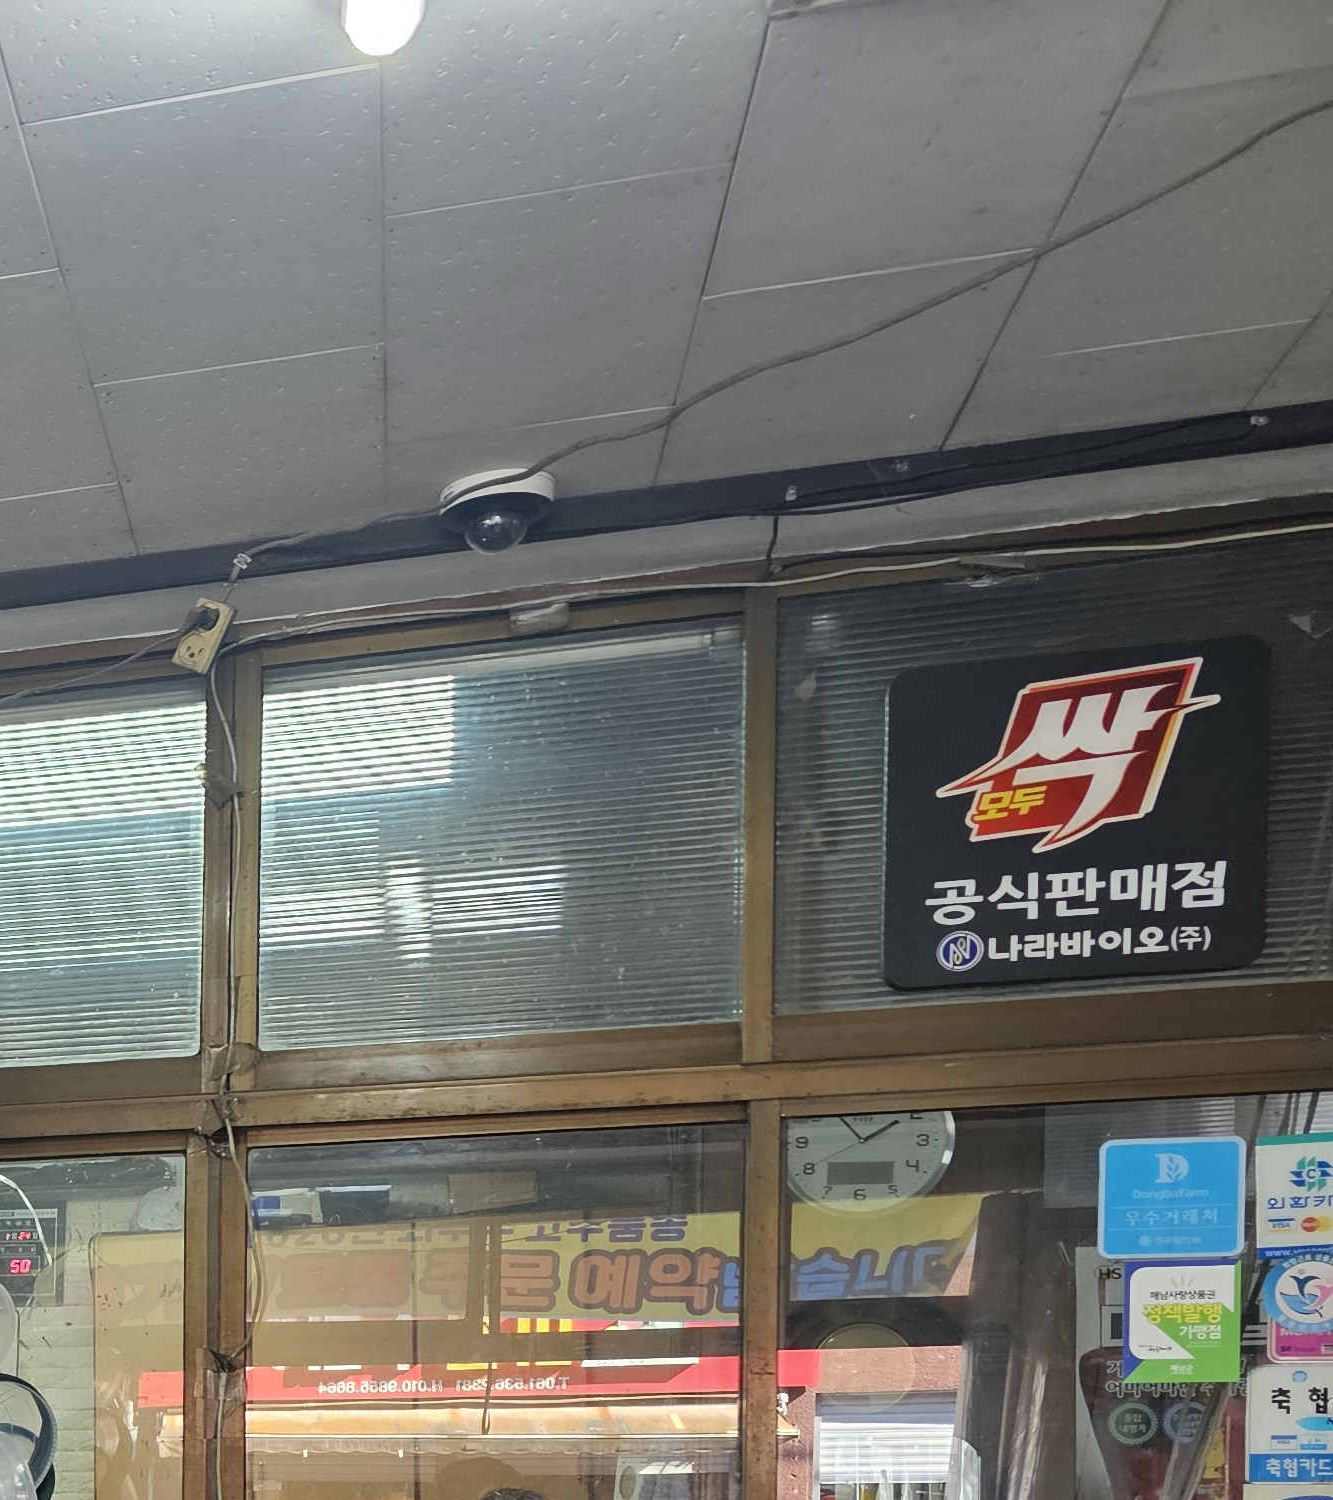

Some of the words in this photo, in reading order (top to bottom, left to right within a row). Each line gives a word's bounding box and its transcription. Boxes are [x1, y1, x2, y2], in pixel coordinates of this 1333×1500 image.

[973, 785, 1047, 820] 모두
[925, 860, 1228, 925] 공식판매점
[988, 927, 1211, 962] 나라바이오(주)
[1124, 1209, 1218, 1227] 우수거래처
[1150, 1290, 1215, 1300] 해남사랑상품권
[1143, 1303, 1222, 1324] 정책발행
[1179, 1324, 1221, 1340] 가맹점
[1266, 1458, 1332, 1477] 축협카드
